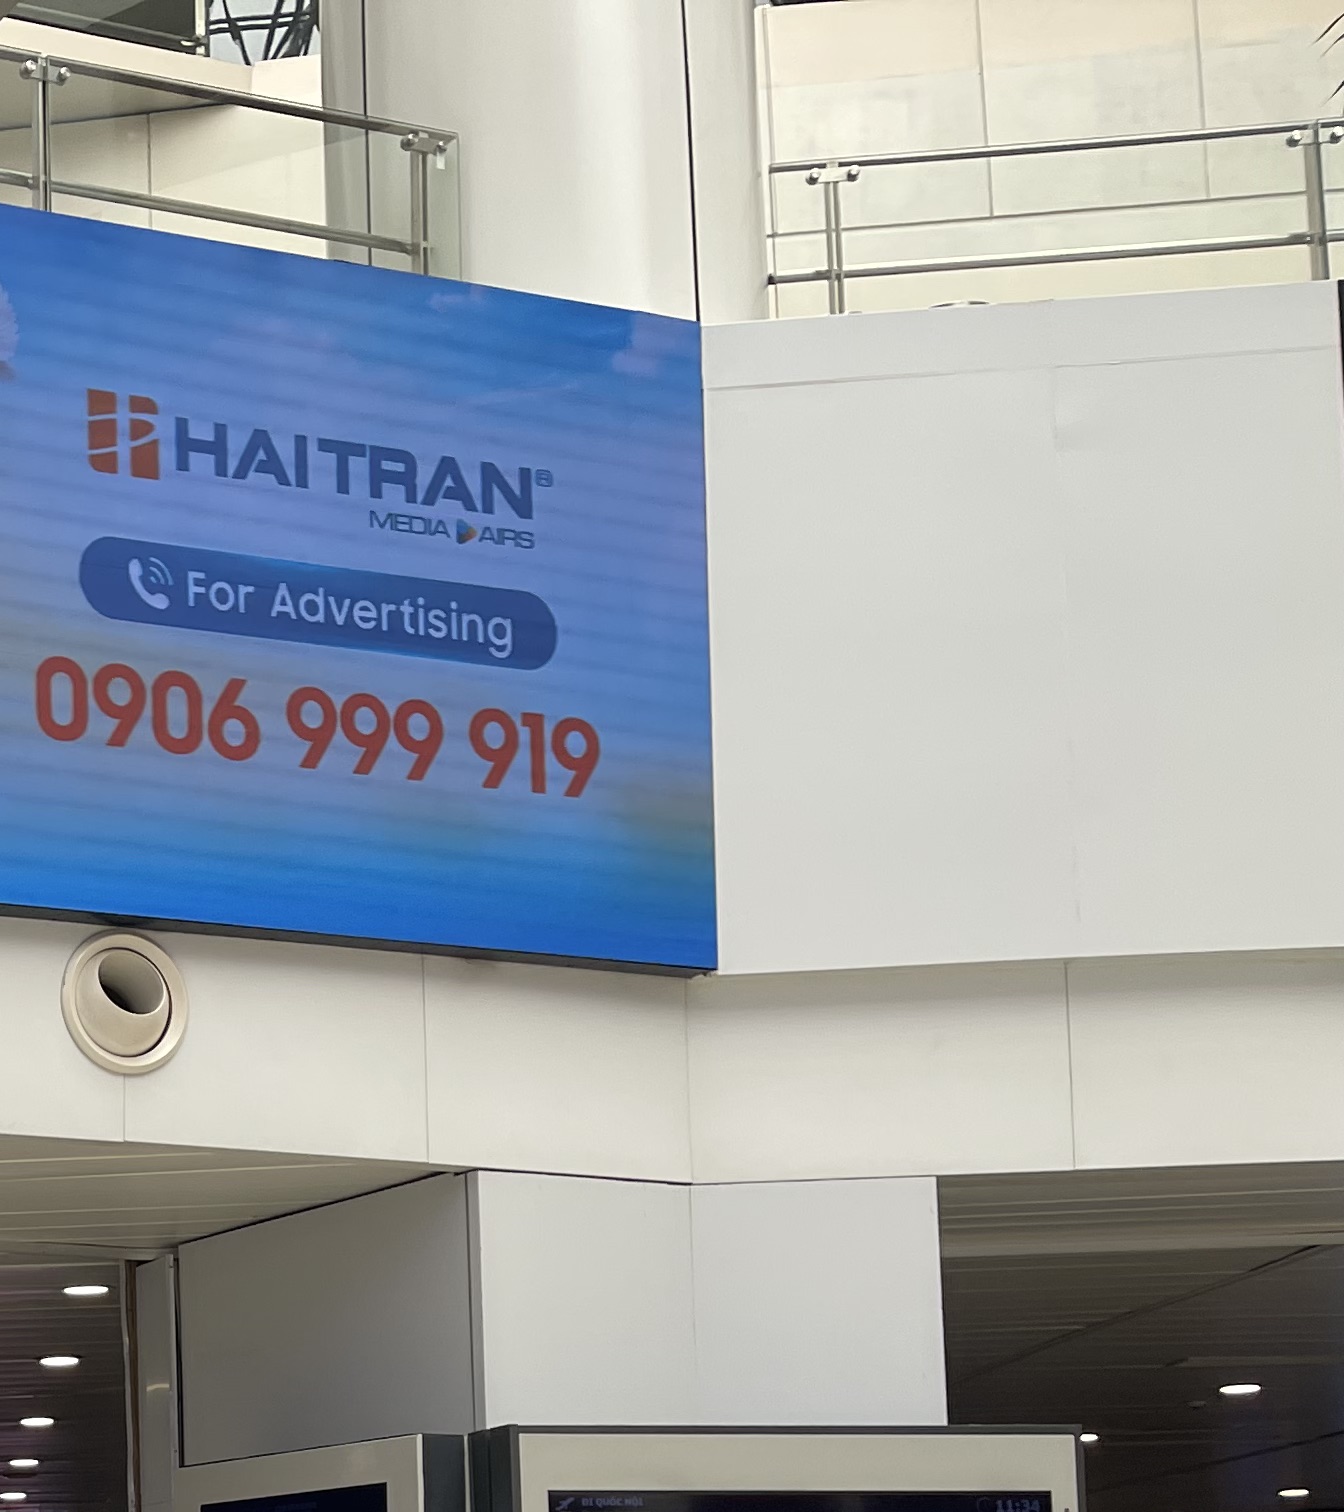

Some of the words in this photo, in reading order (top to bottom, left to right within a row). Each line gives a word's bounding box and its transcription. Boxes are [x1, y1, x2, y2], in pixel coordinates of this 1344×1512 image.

[368, 509, 450, 539] MEDIA
[478, 526, 535, 549] AIRS
[187, 570, 254, 614] For
[270, 582, 513, 658] Advertising
[35, 655, 261, 761] 0906
[285, 686, 444, 781] 999
[468, 706, 600, 798] 919
